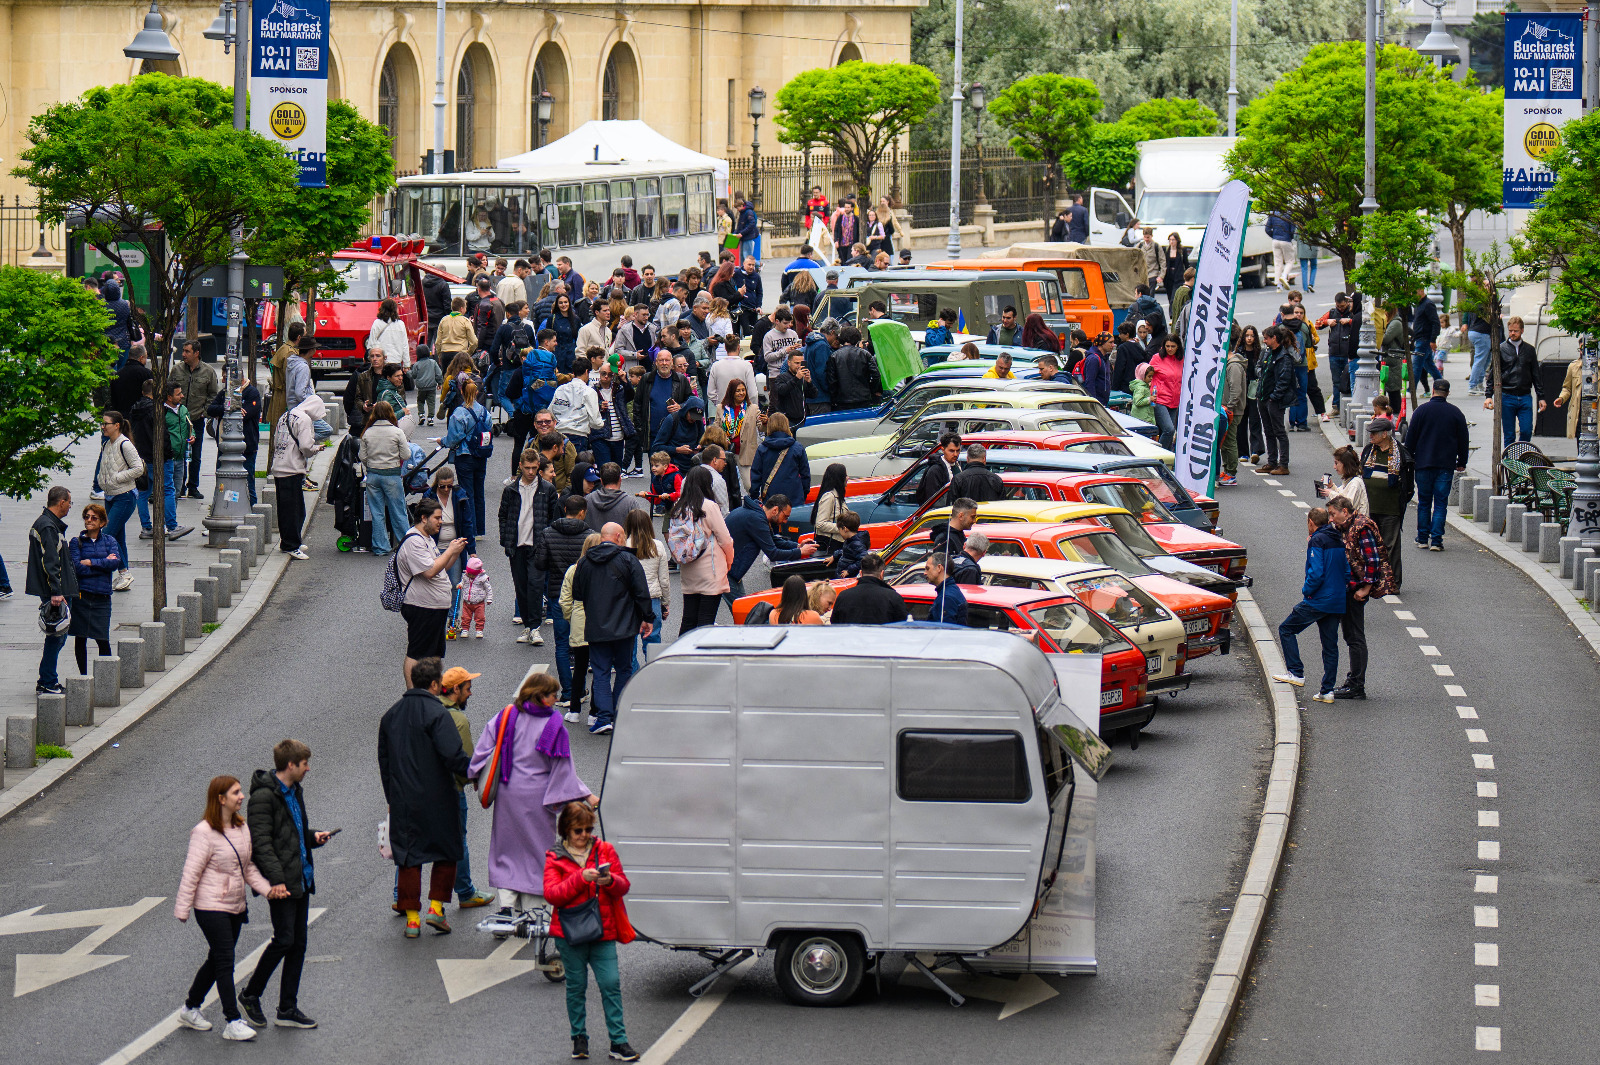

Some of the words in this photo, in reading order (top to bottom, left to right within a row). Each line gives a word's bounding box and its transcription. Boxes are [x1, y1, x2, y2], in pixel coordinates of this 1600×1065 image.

[260, 19, 322, 32] Bucharest
[281, 31, 321, 39] MARATHON
[260, 46, 291, 57] 10-11
[1513, 40, 1574, 53] Bucharest
[260, 58, 290, 70] MAI
[1513, 67, 1545, 78] 10-11
[1513, 79, 1545, 91] MAI
[276, 110, 300, 119] GOLD
[1530, 131, 1555, 140] GOLD
[1189, 422, 1214, 481] CLUB
